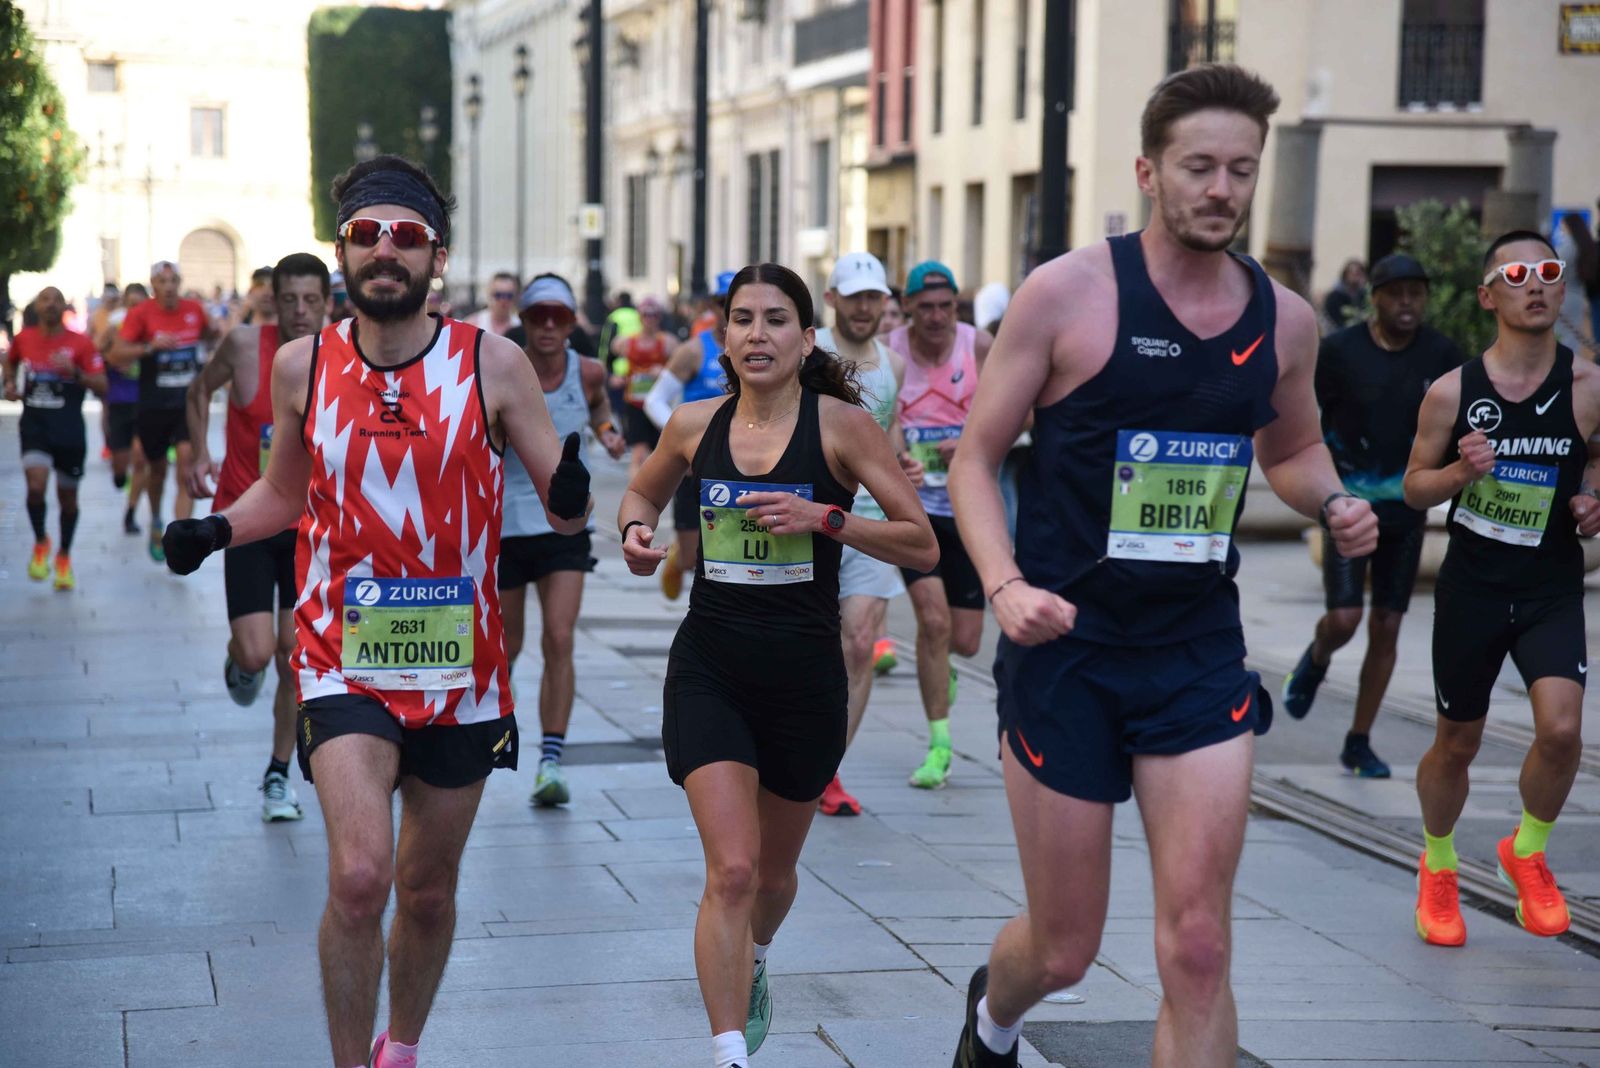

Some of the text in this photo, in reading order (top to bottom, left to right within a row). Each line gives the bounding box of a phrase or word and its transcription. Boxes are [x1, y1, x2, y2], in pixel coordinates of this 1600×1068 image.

[359, 427, 428, 439] Running Team
[1166, 440, 1239, 459] ZURICH
[1499, 466, 1548, 482] ZURICH
[1166, 478, 1207, 496] 1816
[1495, 489, 1521, 503] 2991
[1466, 492, 1542, 527] CLEMENT
[743, 539, 769, 560] LU
[389, 584, 459, 601] ZURICH
[390, 619, 426, 634] 2631
[356, 641, 460, 664] ANTONIO
